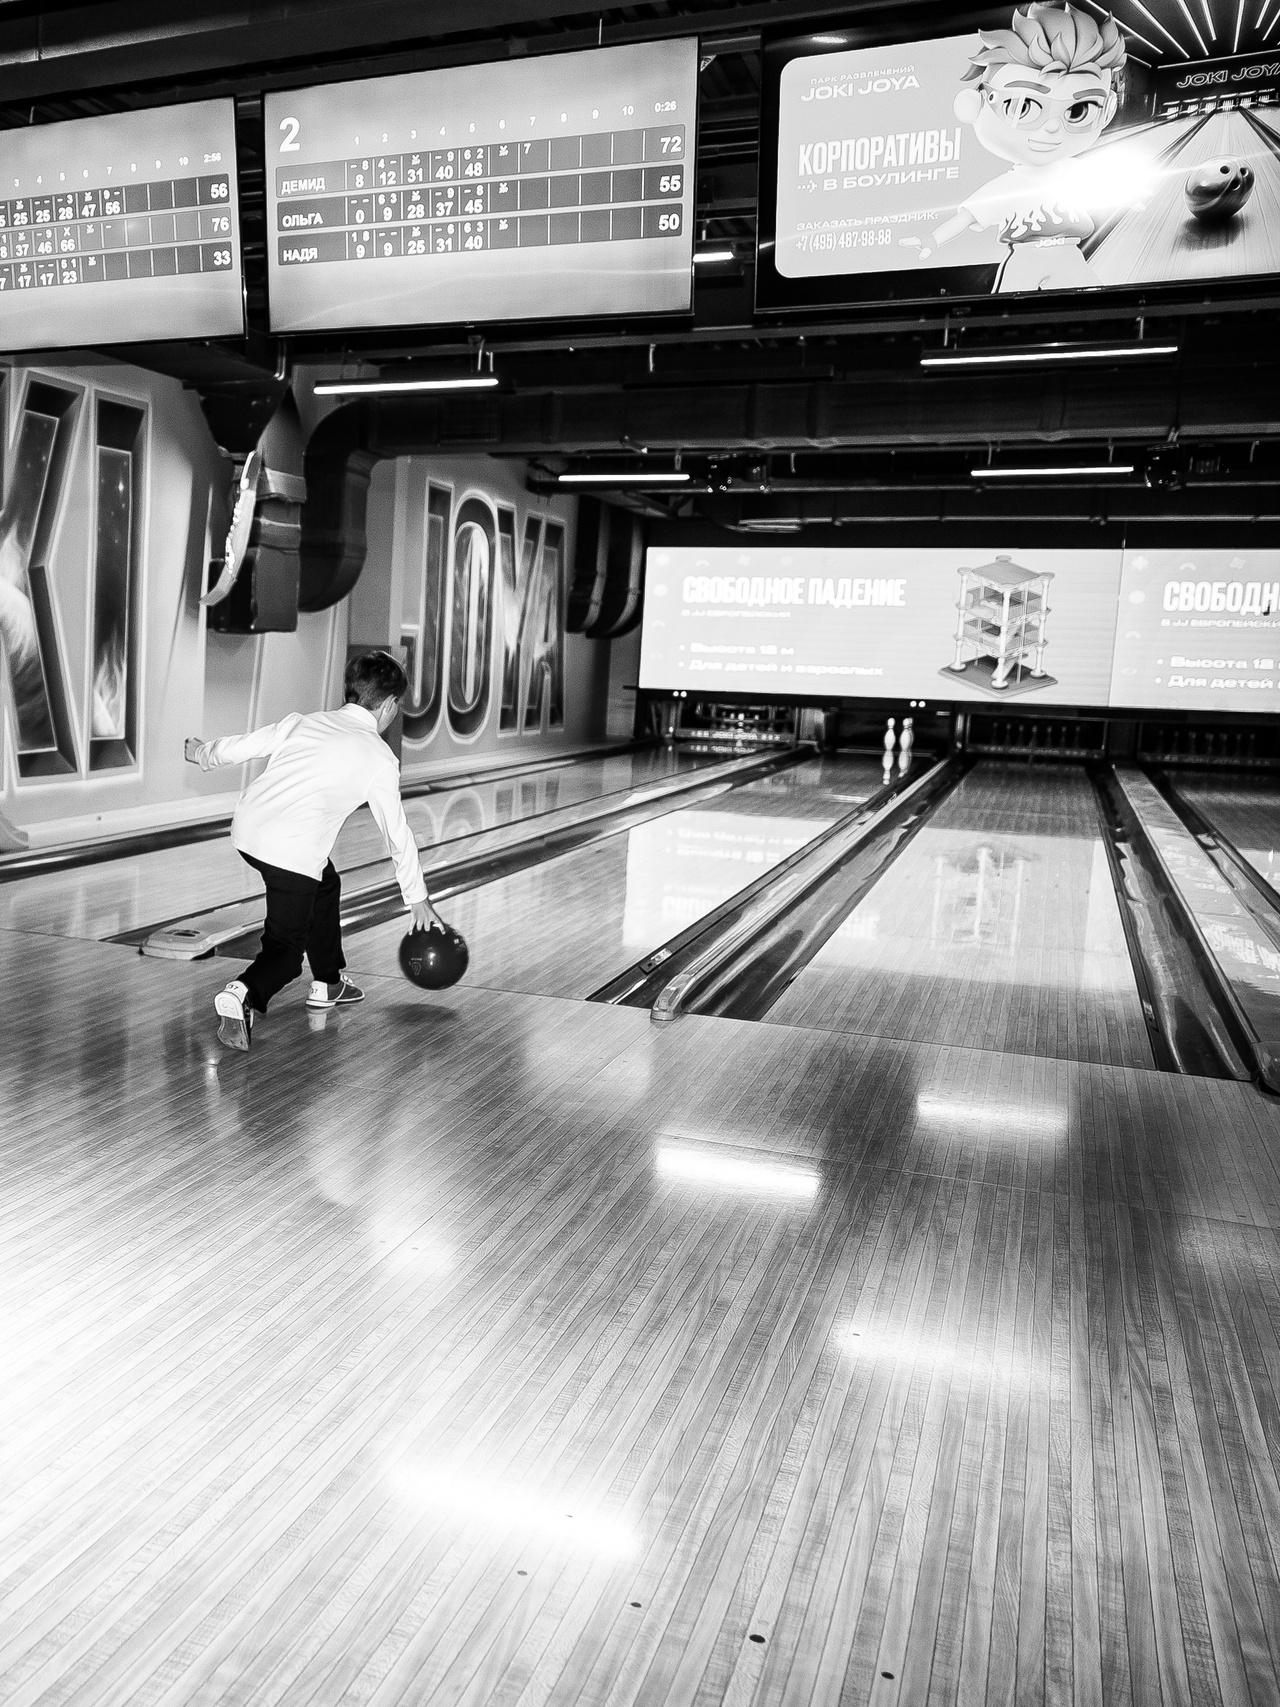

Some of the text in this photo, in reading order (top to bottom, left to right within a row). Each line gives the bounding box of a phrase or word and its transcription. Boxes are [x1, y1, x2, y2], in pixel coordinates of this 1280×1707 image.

[800, 75, 920, 101] JOKI JOYA
[810, 65, 915, 85] ПАРК РАЗВЛЕЧЕНИЙ
[1176, 70, 1228, 88] JOKI
[280, 118, 300, 152] 2
[354, 135, 360, 146] 1
[381, 132, 389, 143] 2
[439, 126, 446, 136] 4
[529, 116, 536, 127] 7
[592, 109, 599, 120] 9
[623, 106, 633, 115] 10
[655, 101, 676, 112] 0:26
[798, 127, 962, 176] КОРПОРАТИВЫ
[106, 166, 113, 175] 7
[179, 157, 188, 165] 10
[282, 136, 681, 196] ДЕМИД 8 12 31 40 48 72
[823, 166, 960, 191] В БОУЛИНГЕ
[14, 212, 29, 226] 25
[36, 210, 50, 222] 25
[59, 207, 75, 221] 28
[82, 204, 97, 218] 47
[106, 201, 120, 214] 56
[211, 183, 227, 198] 56
[283, 213, 324, 229] ОЛЬГА
[384, 207, 392, 221] 9
[407, 204, 426, 220] 28
[436, 202, 455, 218] 37
[465, 199, 483, 213] 45
[660, 175, 680, 192] 55
[796, 211, 939, 231] ЗАКАЗАТЬ ПРАЗДНИК:
[16, 244, 29, 256] 37
[38, 242, 52, 254] 46
[61, 239, 75, 251] 66
[212, 217, 229, 231] 76
[284, 248, 317, 262] НАДЯ
[356, 245, 365, 258] 9
[384, 243, 392, 256] 9
[437, 238, 455, 253] 31
[465, 235, 484, 251] 40
[659, 214, 679, 230] 50
[796, 235, 808, 251] +7
[1035, 237, 1065, 248] JOKI
[18, 275, 33, 289] 17
[40, 273, 56, 287] 17
[63, 271, 79, 285] 23
[214, 251, 230, 265] 33
[682, 576, 907, 609] СВОБОДНОЕ ПАДЕНИЕ
[1163, 580, 1280, 616] СВОБОДН
[689, 659, 723, 672] Для
[1170, 655, 1248, 669] Высота
[1167, 674, 1274, 689] Для детей
